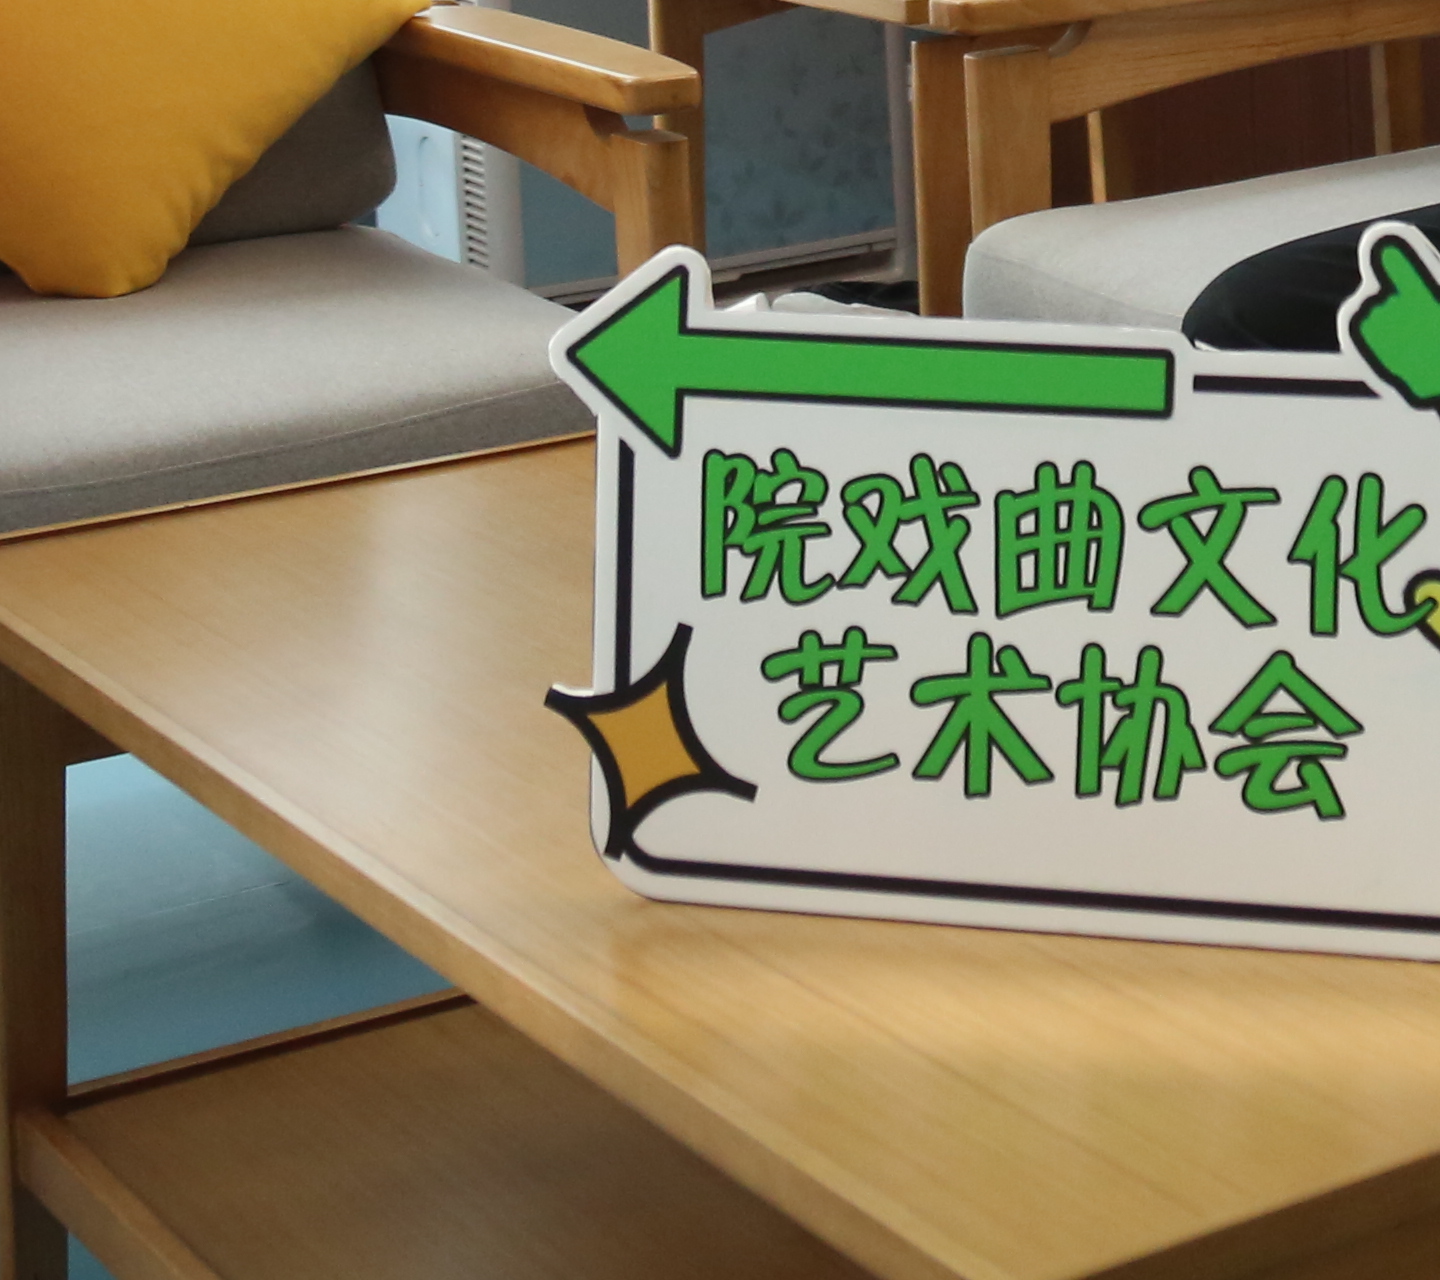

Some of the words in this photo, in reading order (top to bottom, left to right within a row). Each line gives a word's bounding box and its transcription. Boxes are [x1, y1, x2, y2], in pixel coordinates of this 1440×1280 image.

[700, 448, 1439, 637] 院戏曲文化
[760, 626, 1364, 819] 艺术协会
